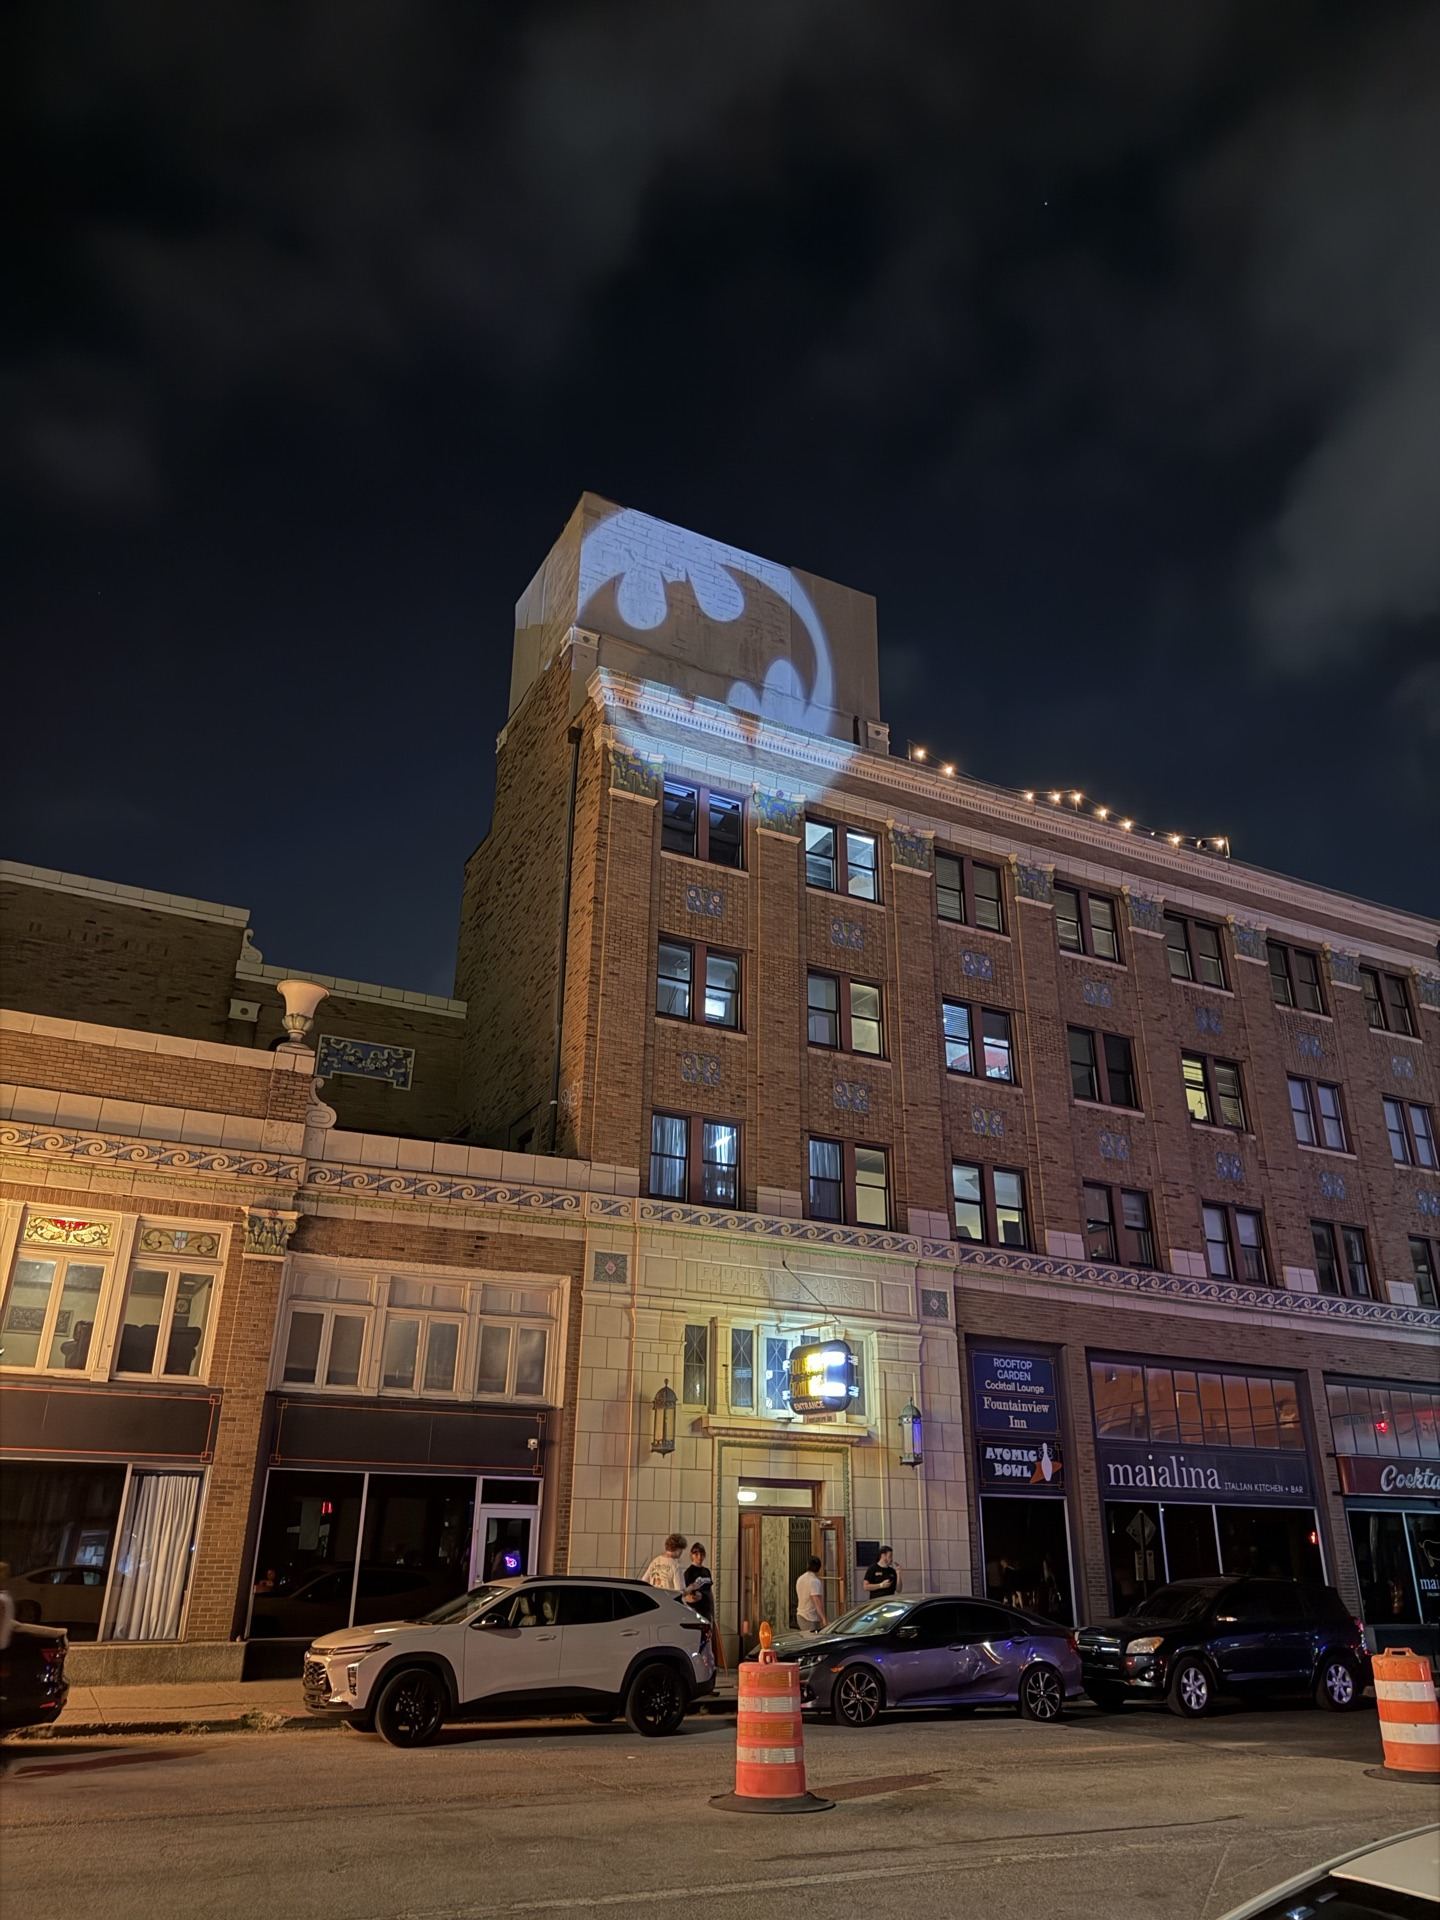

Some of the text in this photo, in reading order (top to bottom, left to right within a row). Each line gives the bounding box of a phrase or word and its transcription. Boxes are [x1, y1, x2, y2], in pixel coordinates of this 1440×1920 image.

[993, 1358, 1033, 1370] ROOFTOP
[997, 1370, 1031, 1381] GARDEN
[985, 1380, 1045, 1394] Cocktail Lounge
[793, 1401, 824, 1411] ENTRANCE
[983, 1397, 1050, 1413] Fountainview
[1008, 1415, 1028, 1429] Inn
[985, 1447, 1038, 1462] ATOMIC
[993, 1462, 1032, 1477] BOWL
[1107, 1454, 1222, 1490] maialina
[1224, 1482, 1253, 1491] ITALIAN
[1254, 1483, 1283, 1492] KITCHEN
[1290, 1485, 1304, 1493] BAR
